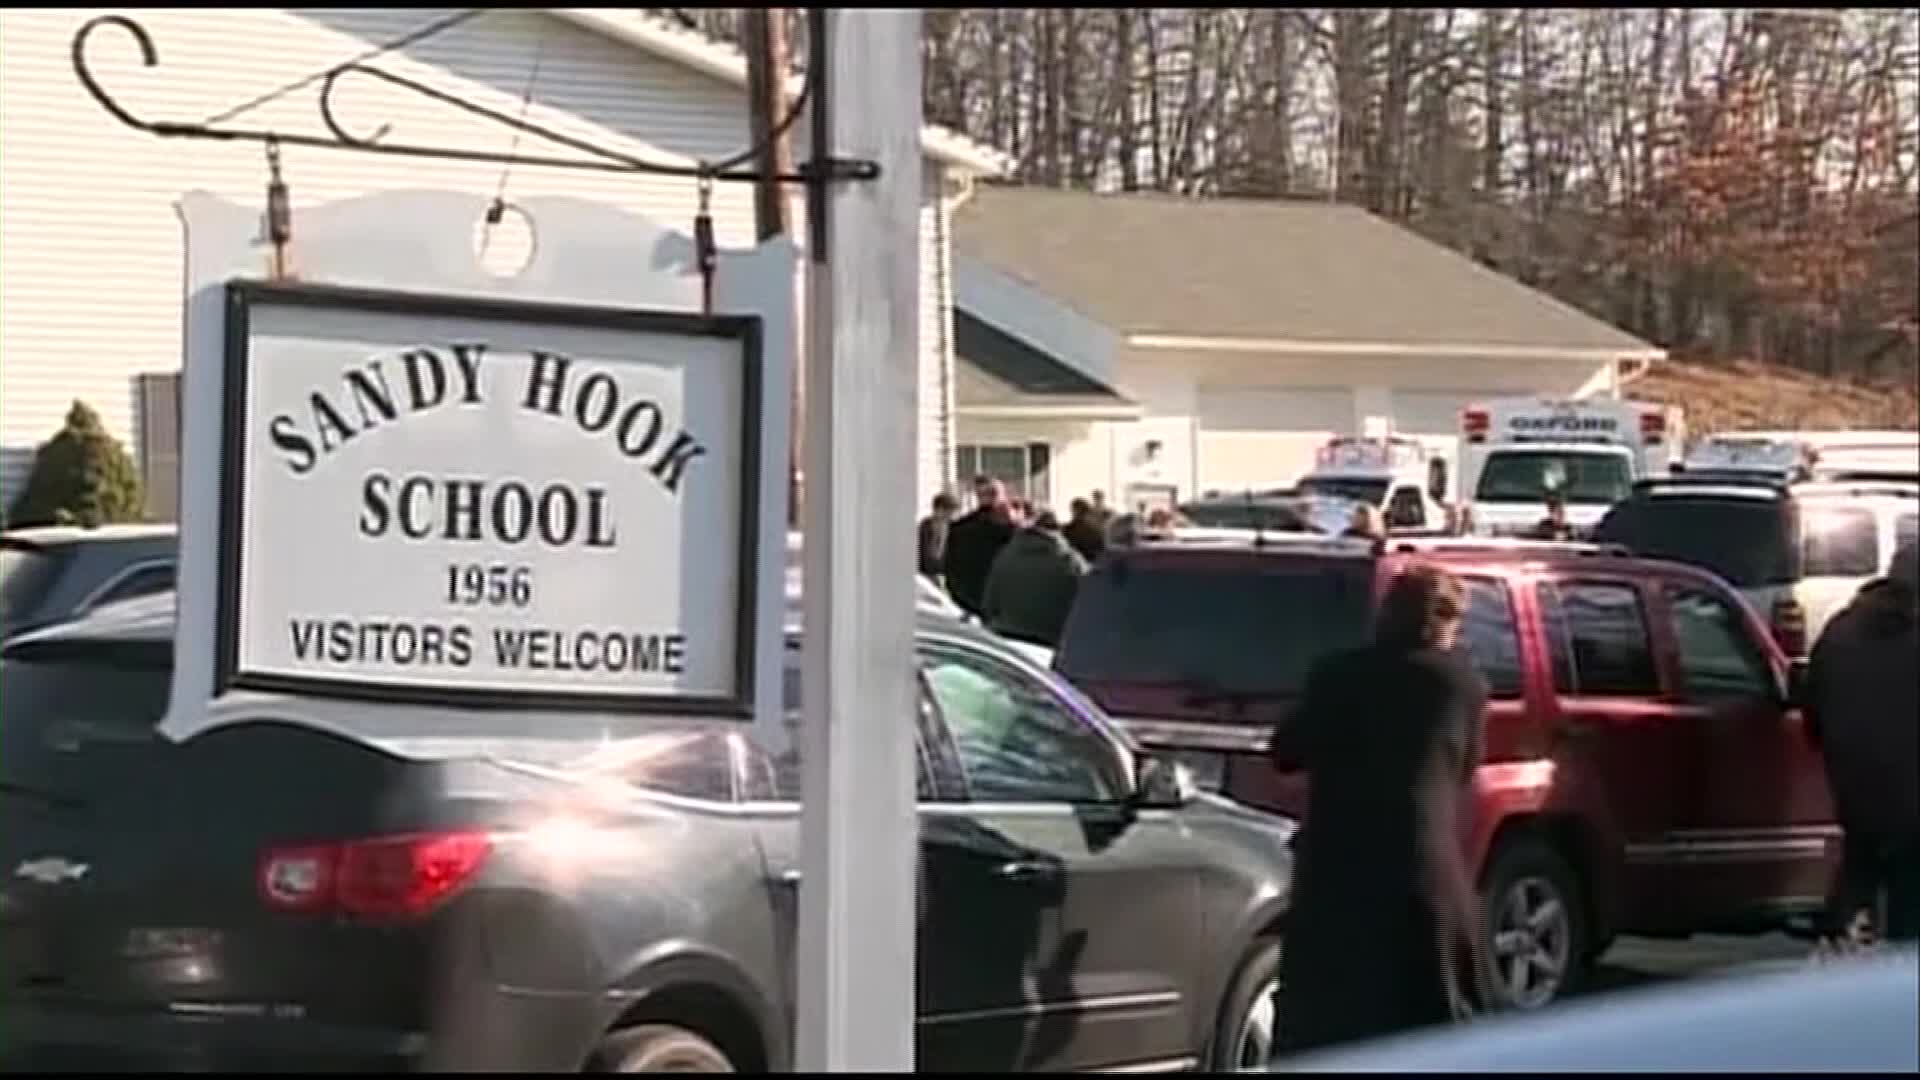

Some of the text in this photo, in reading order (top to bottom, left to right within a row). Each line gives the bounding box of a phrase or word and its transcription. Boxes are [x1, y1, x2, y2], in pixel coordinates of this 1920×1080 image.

[269, 344, 706, 493] SANDY HOOK
[360, 474, 616, 547] SCHOOL
[446, 565, 532, 606] 1956
[290, 620, 686, 673] VISITORS WELCOME
